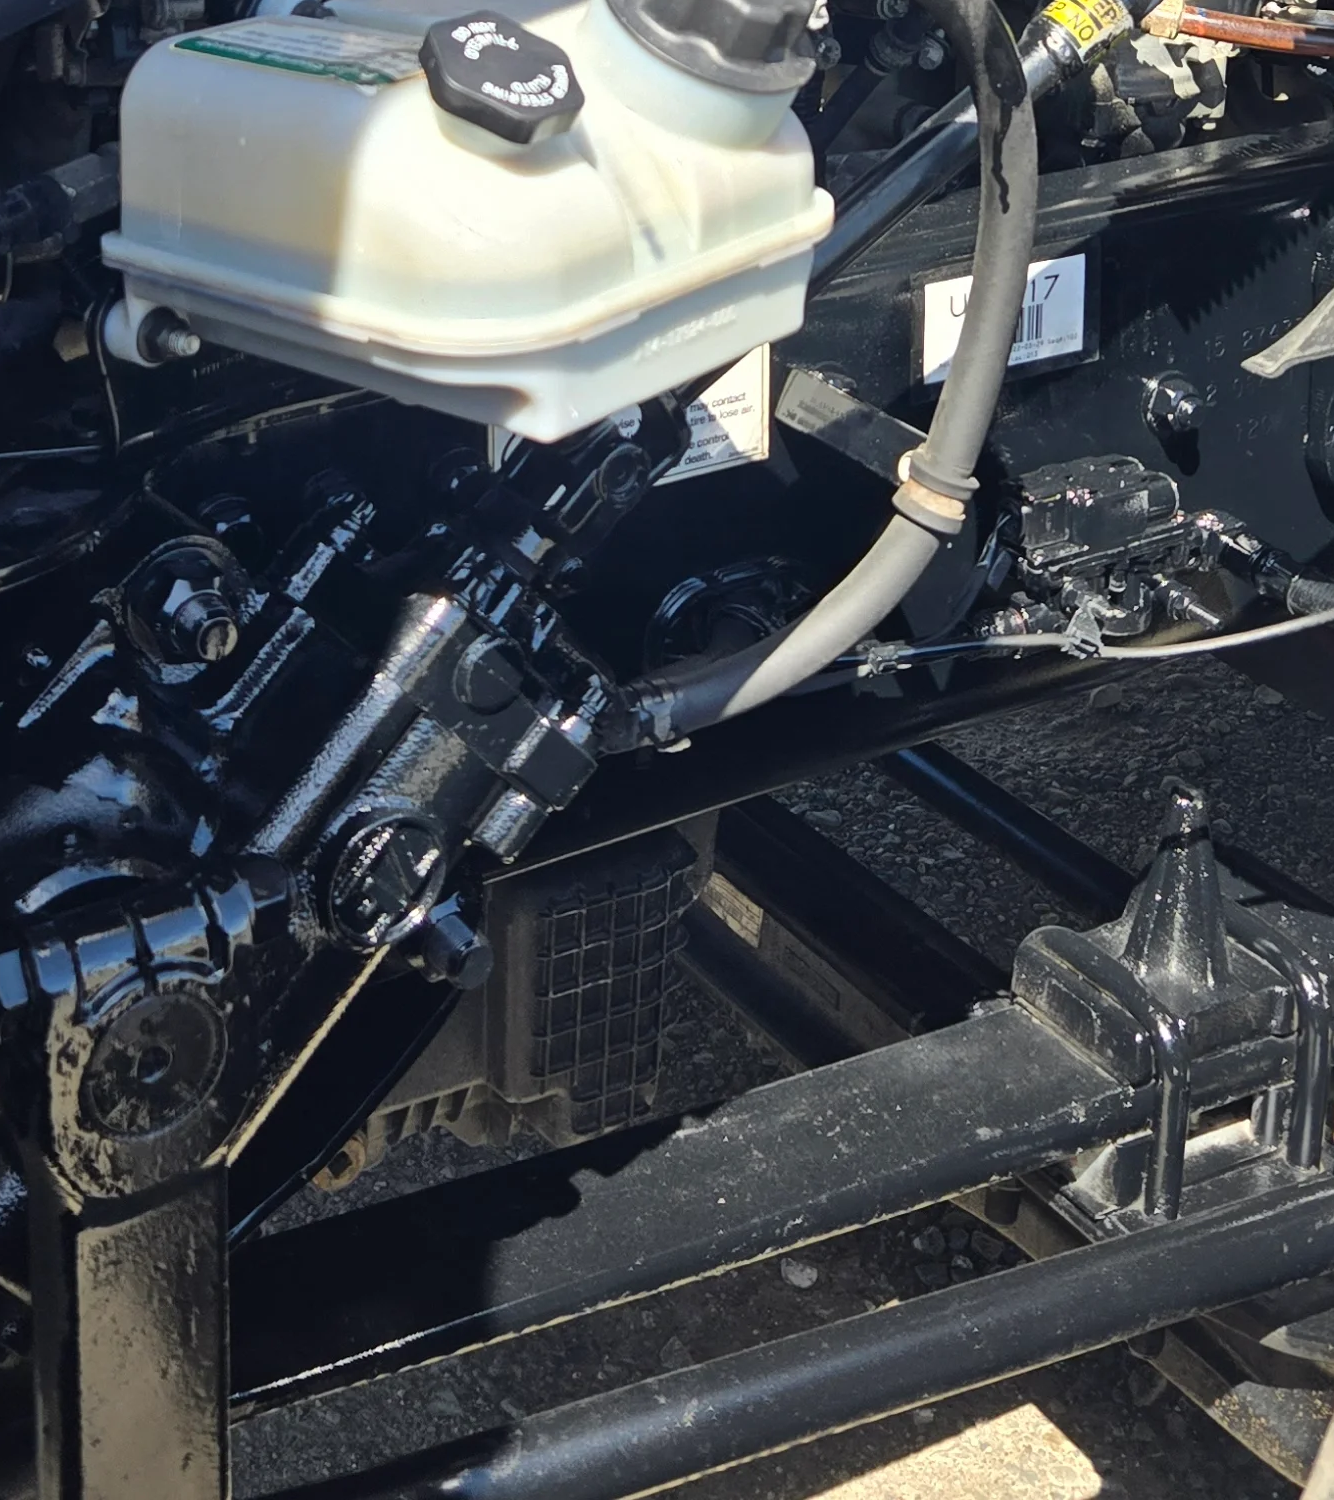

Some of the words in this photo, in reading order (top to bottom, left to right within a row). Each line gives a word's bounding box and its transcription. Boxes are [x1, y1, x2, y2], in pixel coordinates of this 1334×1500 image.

[451, 26, 471, 43] DO
[468, 21, 497, 34] NOT
[510, 74, 552, 94] FLUID
[711, 392, 747, 408] contact
[719, 406, 739, 419] lose
[684, 451, 713, 465] death.
